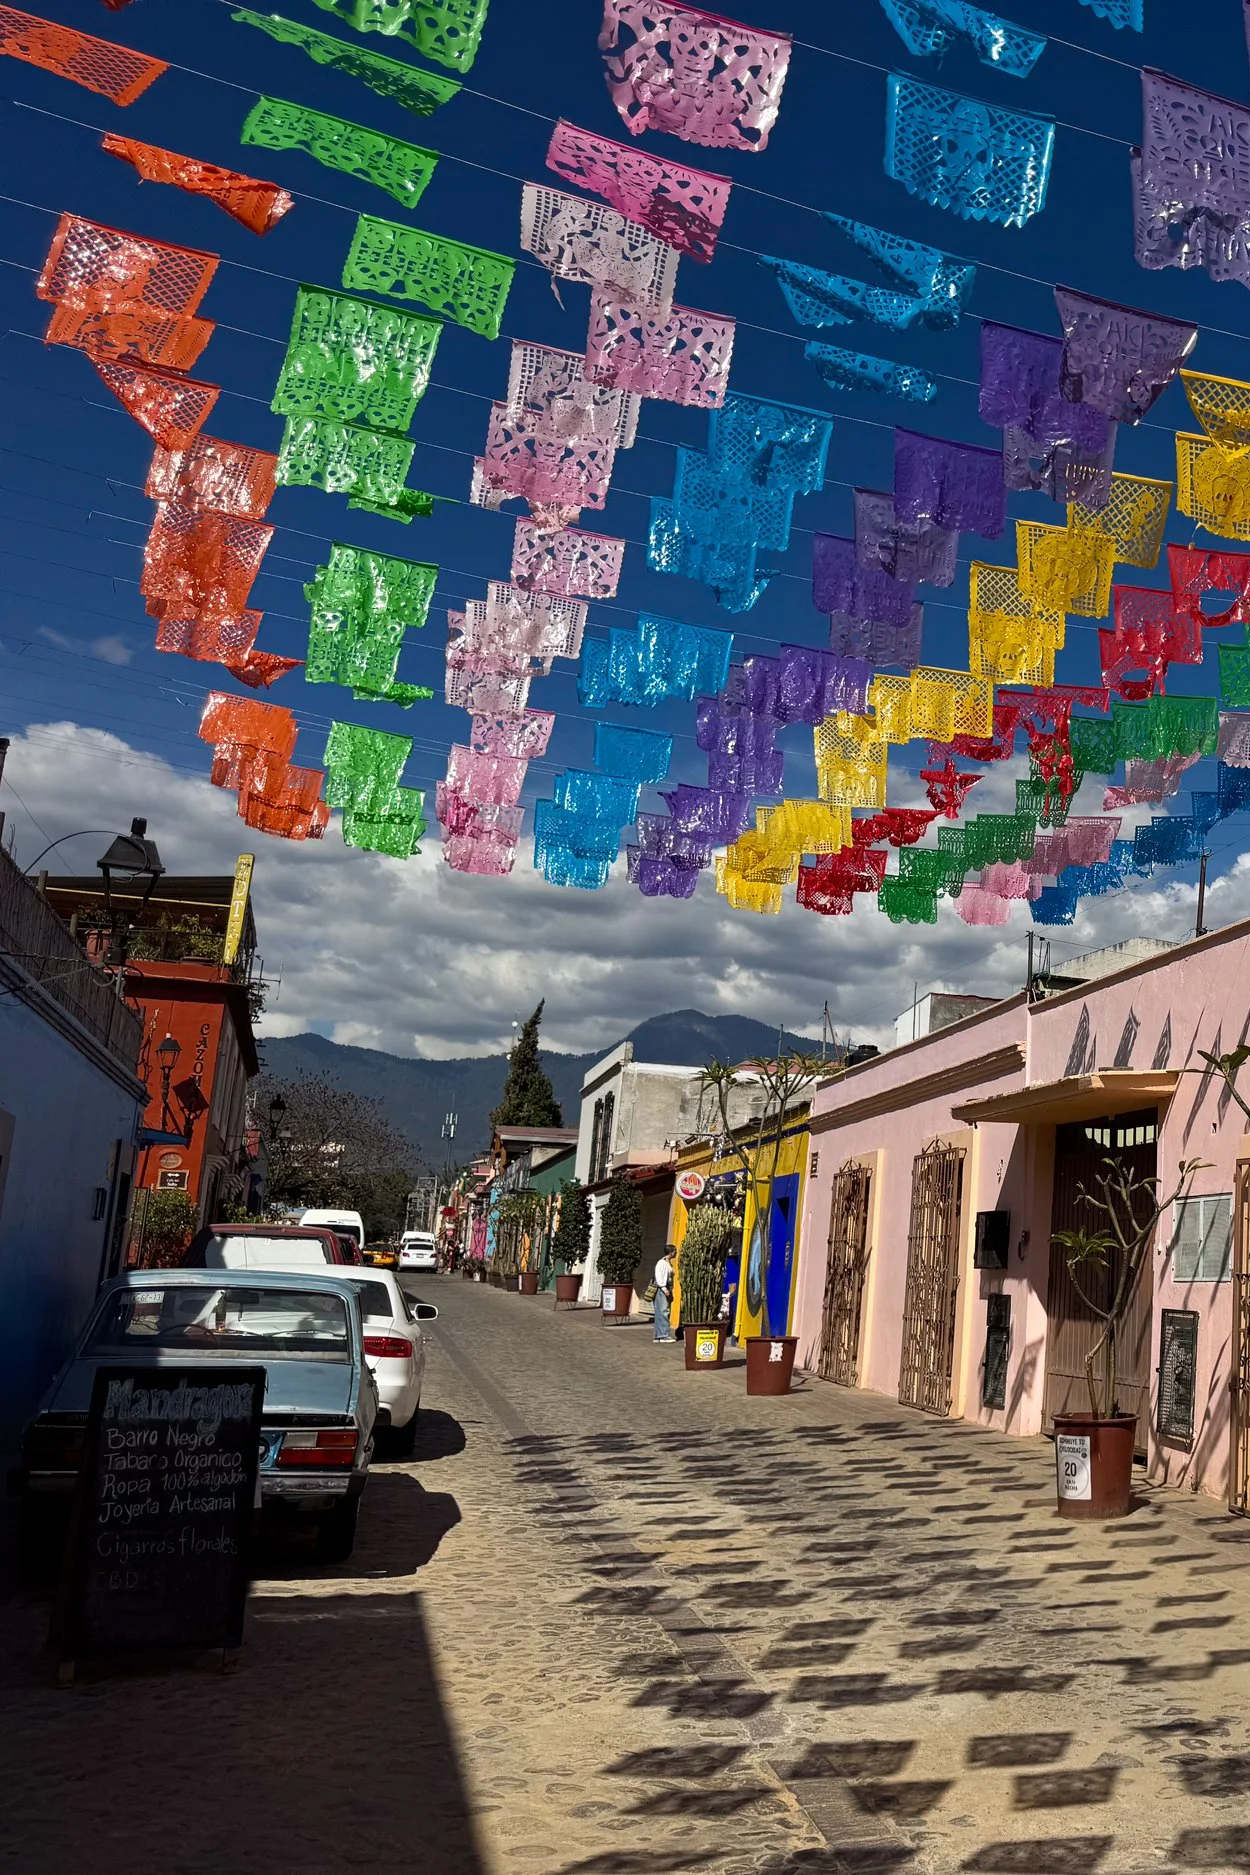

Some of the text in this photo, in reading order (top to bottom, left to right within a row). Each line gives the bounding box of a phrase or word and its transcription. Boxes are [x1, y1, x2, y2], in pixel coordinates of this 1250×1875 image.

[702, 1342, 713, 1351] 20
[105, 1424, 216, 1451] Barro Negro
[1064, 1461, 1077, 1477] 20
[101, 1473, 152, 1500] Ropa
[168, 1491, 236, 1514] Artesanal
[96, 1531, 176, 1565] Cigarros
